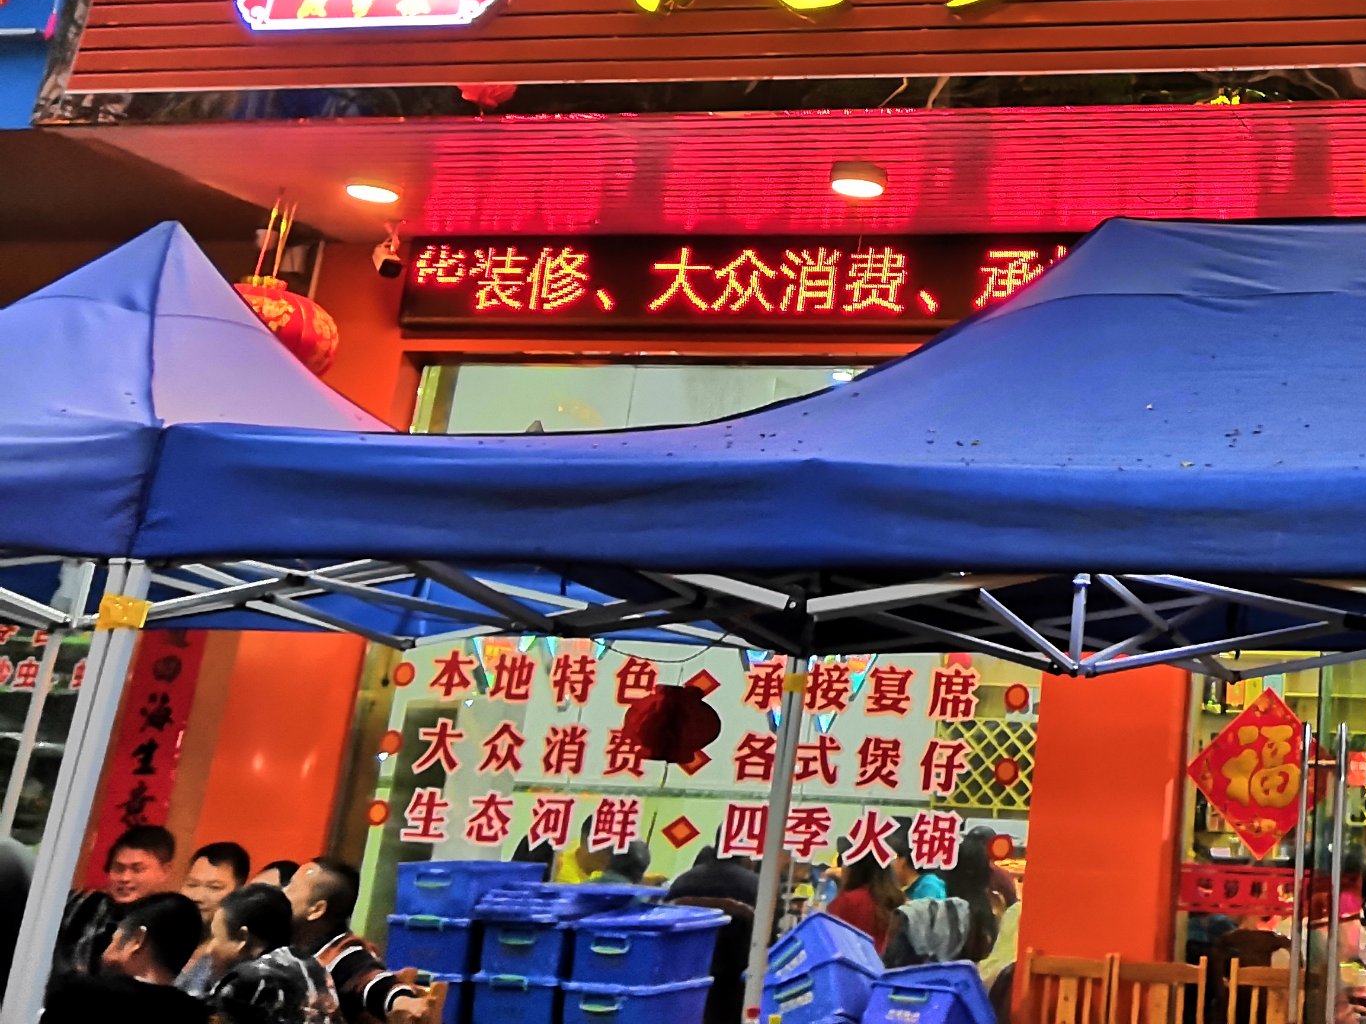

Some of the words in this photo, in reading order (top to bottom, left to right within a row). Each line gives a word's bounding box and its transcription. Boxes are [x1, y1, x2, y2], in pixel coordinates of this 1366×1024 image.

[429, 649, 658, 704] 本地特色
[743, 662, 977, 719] 承接宴席
[412, 721, 646, 775] 大众消费
[735, 733, 967, 793] 各式煲仔
[1222, 725, 1301, 808] 福
[401, 789, 640, 850] 生态河鲜
[719, 803, 963, 866] 四季火锅
